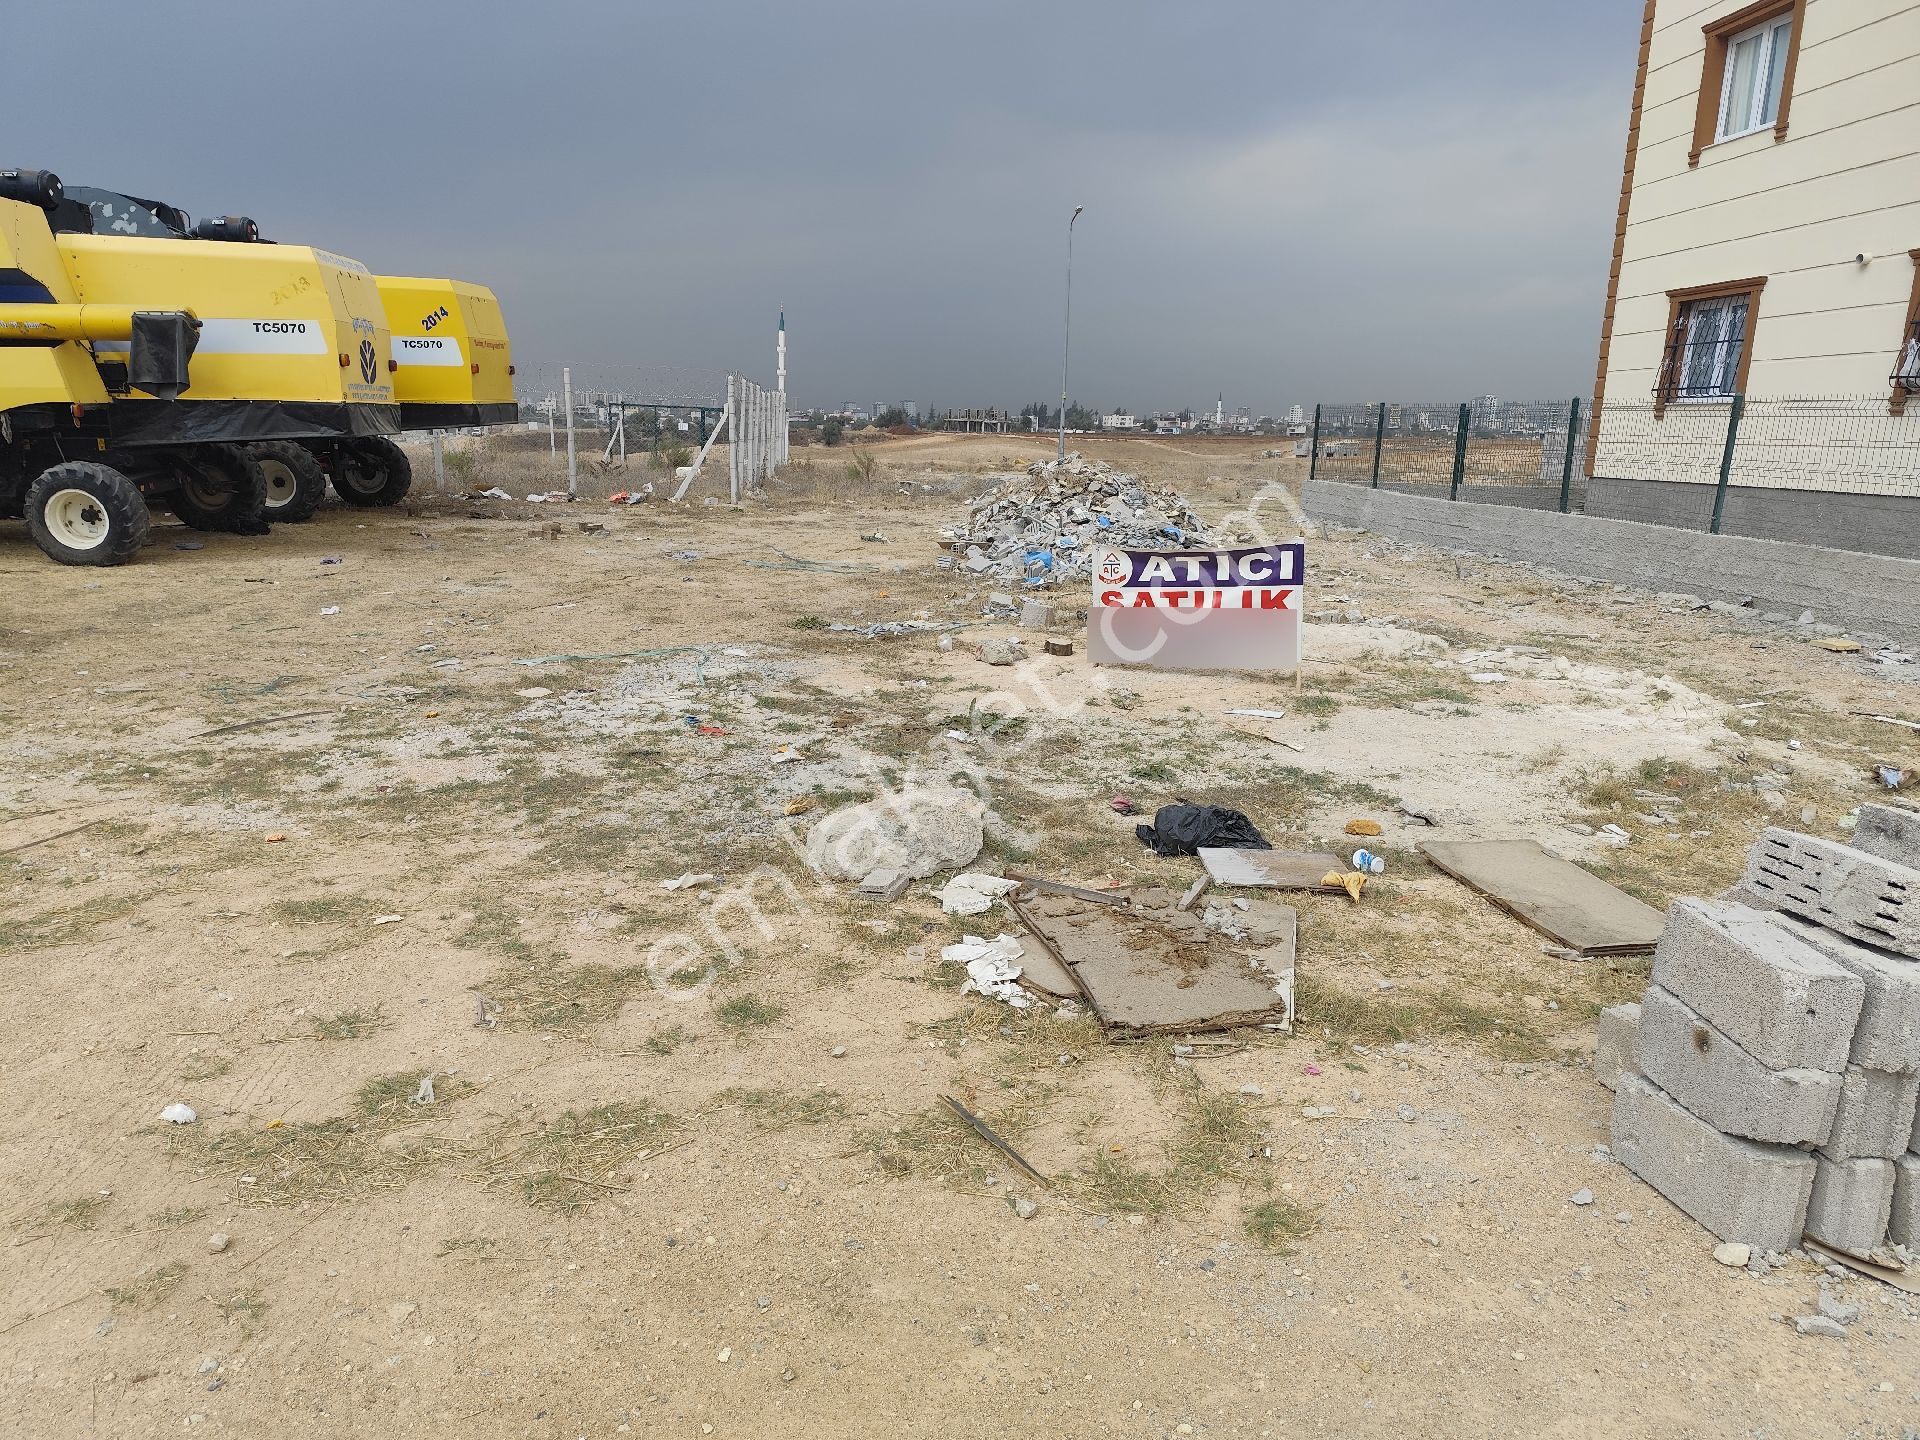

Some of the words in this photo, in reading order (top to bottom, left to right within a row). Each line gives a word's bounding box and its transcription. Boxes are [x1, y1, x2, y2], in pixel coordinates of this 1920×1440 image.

[422, 306, 449, 331] 2014
[253, 322, 306, 334] TC5070
[402, 340, 443, 349] TC5070
[1138, 550, 1294, 581] ATICI
